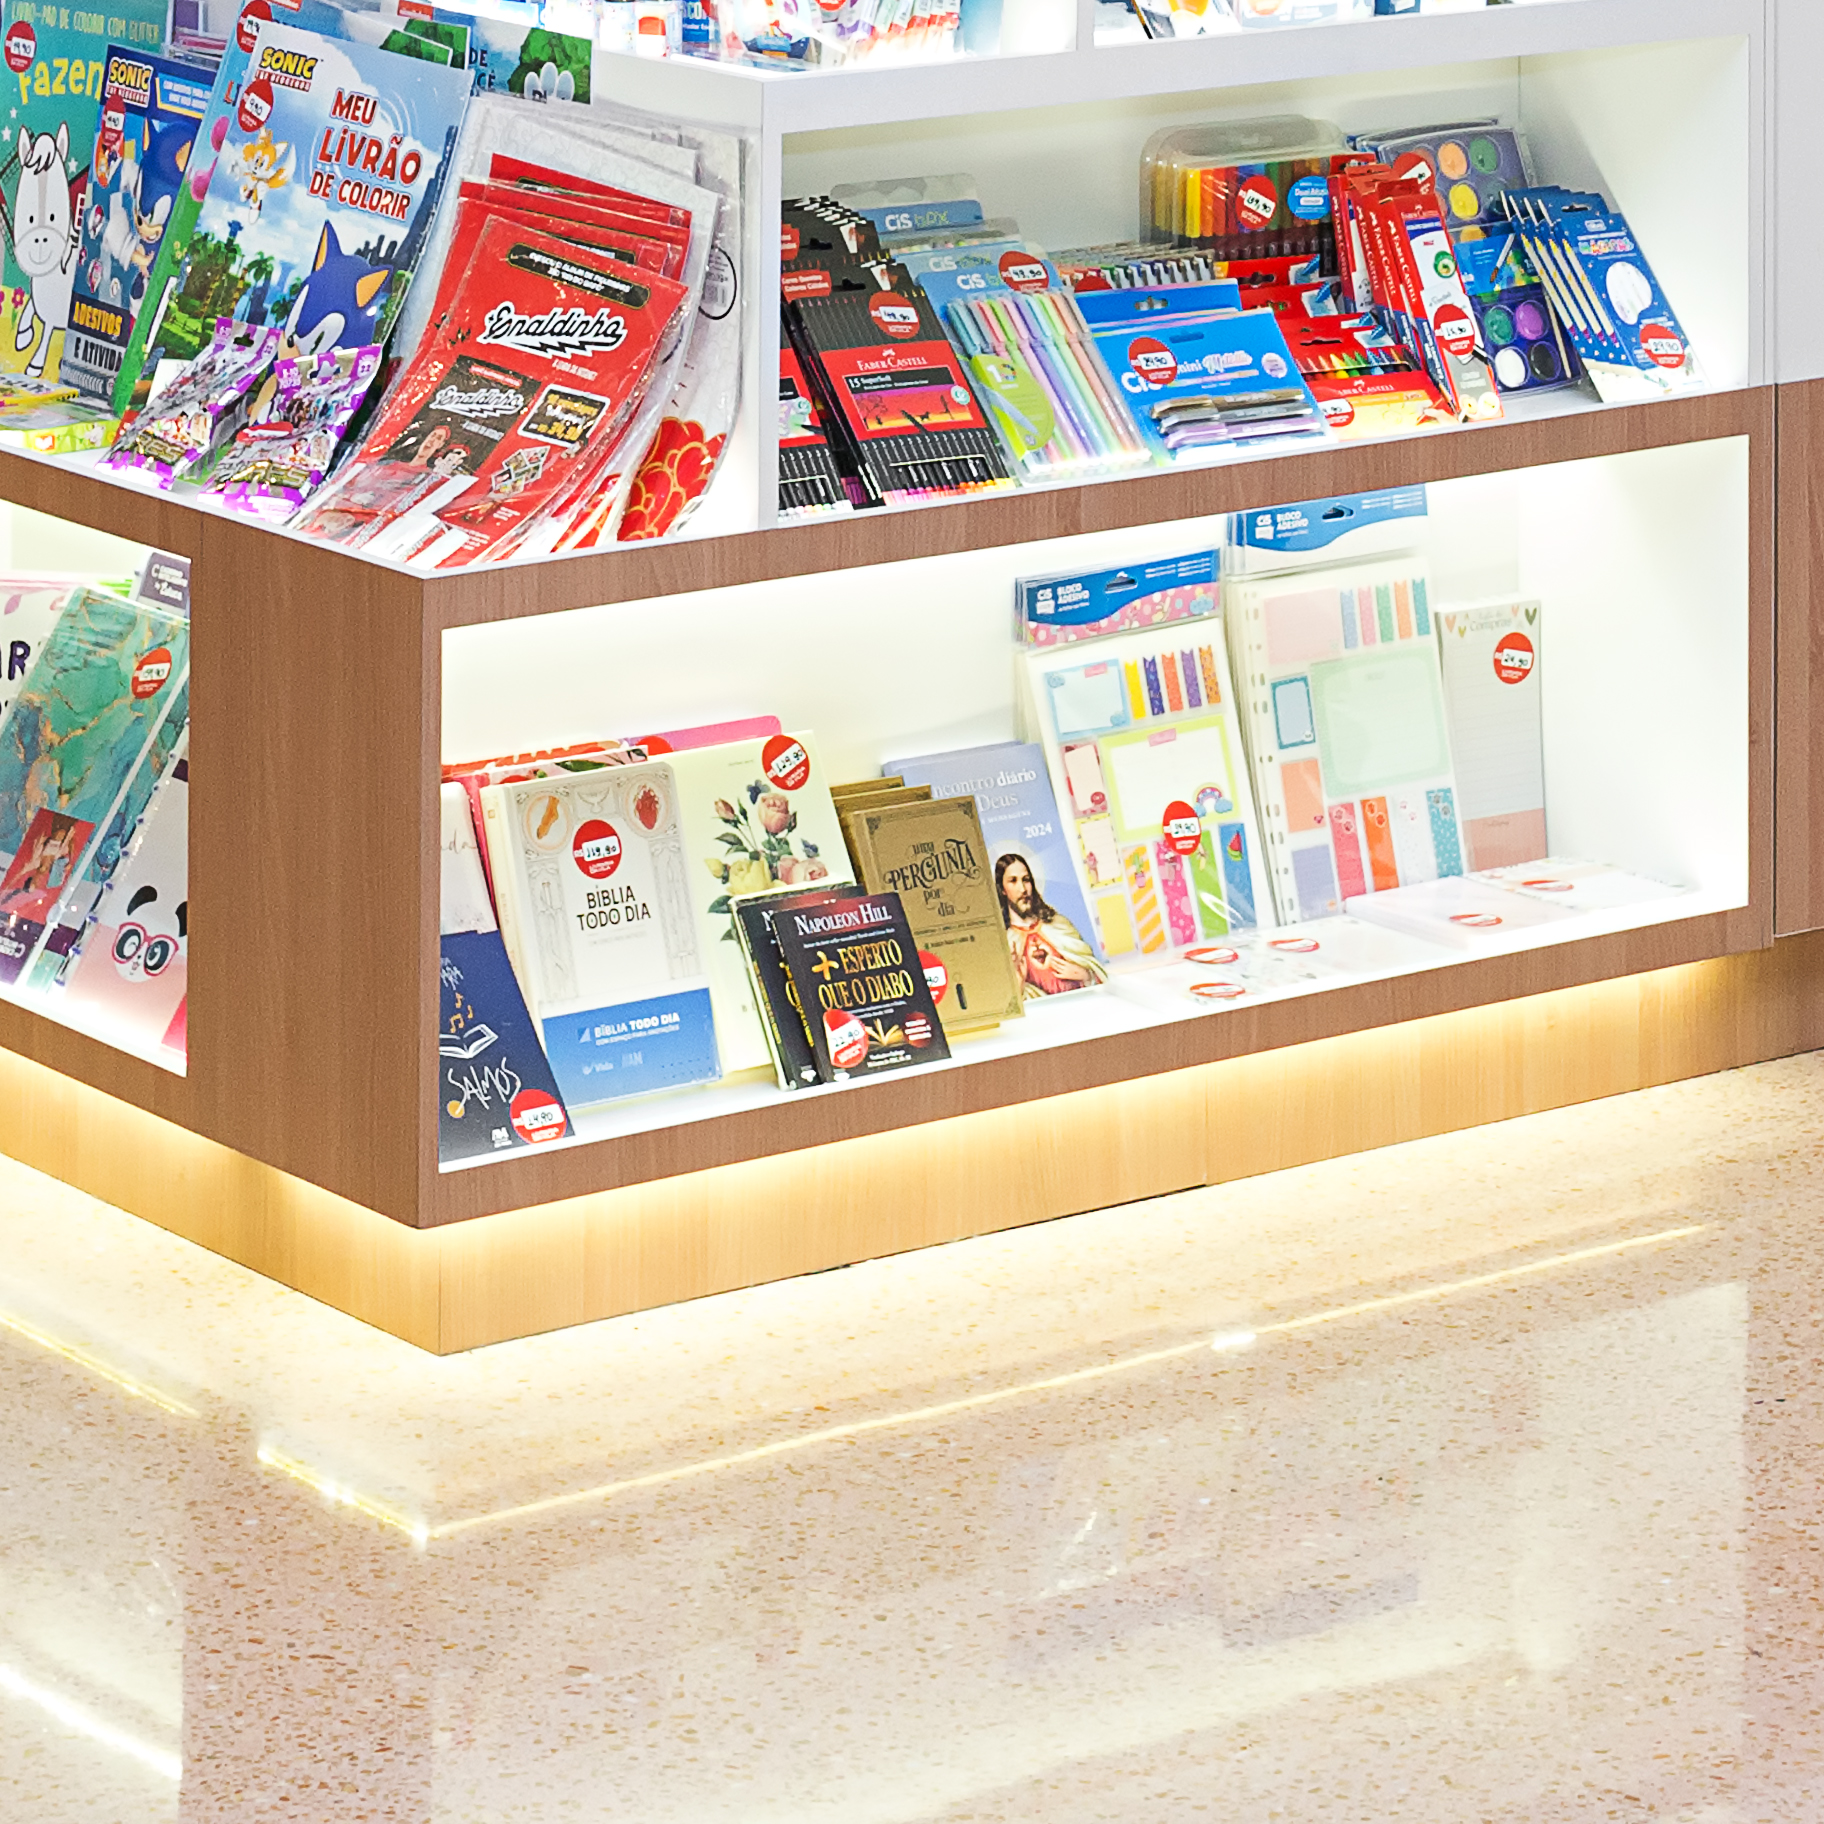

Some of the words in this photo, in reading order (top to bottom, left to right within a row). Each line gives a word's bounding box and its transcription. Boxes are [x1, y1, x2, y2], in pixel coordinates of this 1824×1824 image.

[109, 59, 153, 91] SONIC
[260, 46, 318, 79] SONIC
[332, 88, 378, 125] MEU
[308, 169, 333, 200] DE
[336, 178, 412, 221] COLORIR
[73, 301, 122, 336] ADESIVOS
[848, 377, 861, 389] 15
[1277, 510, 1302, 521] BLOCO
[1277, 517, 1310, 531] ADESIVO
[1056, 583, 1082, 594] BLOCO
[1057, 590, 1090, 604] ADESIVO
[997, 767, 1037, 787] diário
[977, 791, 1019, 812] Deus
[1023, 822, 1053, 839] 2024
[885, 838, 978, 892] PERGUNTA
[587, 883, 636, 909] BÍBLIA
[576, 909, 622, 932] TODO
[625, 902, 651, 924] DIA
[859, 902, 892, 925] HILL
[937, 903, 956, 917] dia
[838, 939, 903, 975] ESPERTO
[818, 978, 853, 1011] QUE
[853, 977, 867, 1005] O
[867, 969, 915, 1002] DIABO
[594, 1022, 629, 1039] BÍBLIA
[629, 1015, 659, 1032] TODO
[660, 1012, 680, 1026] DIA
[447, 1056, 521, 1111] SALMOS
